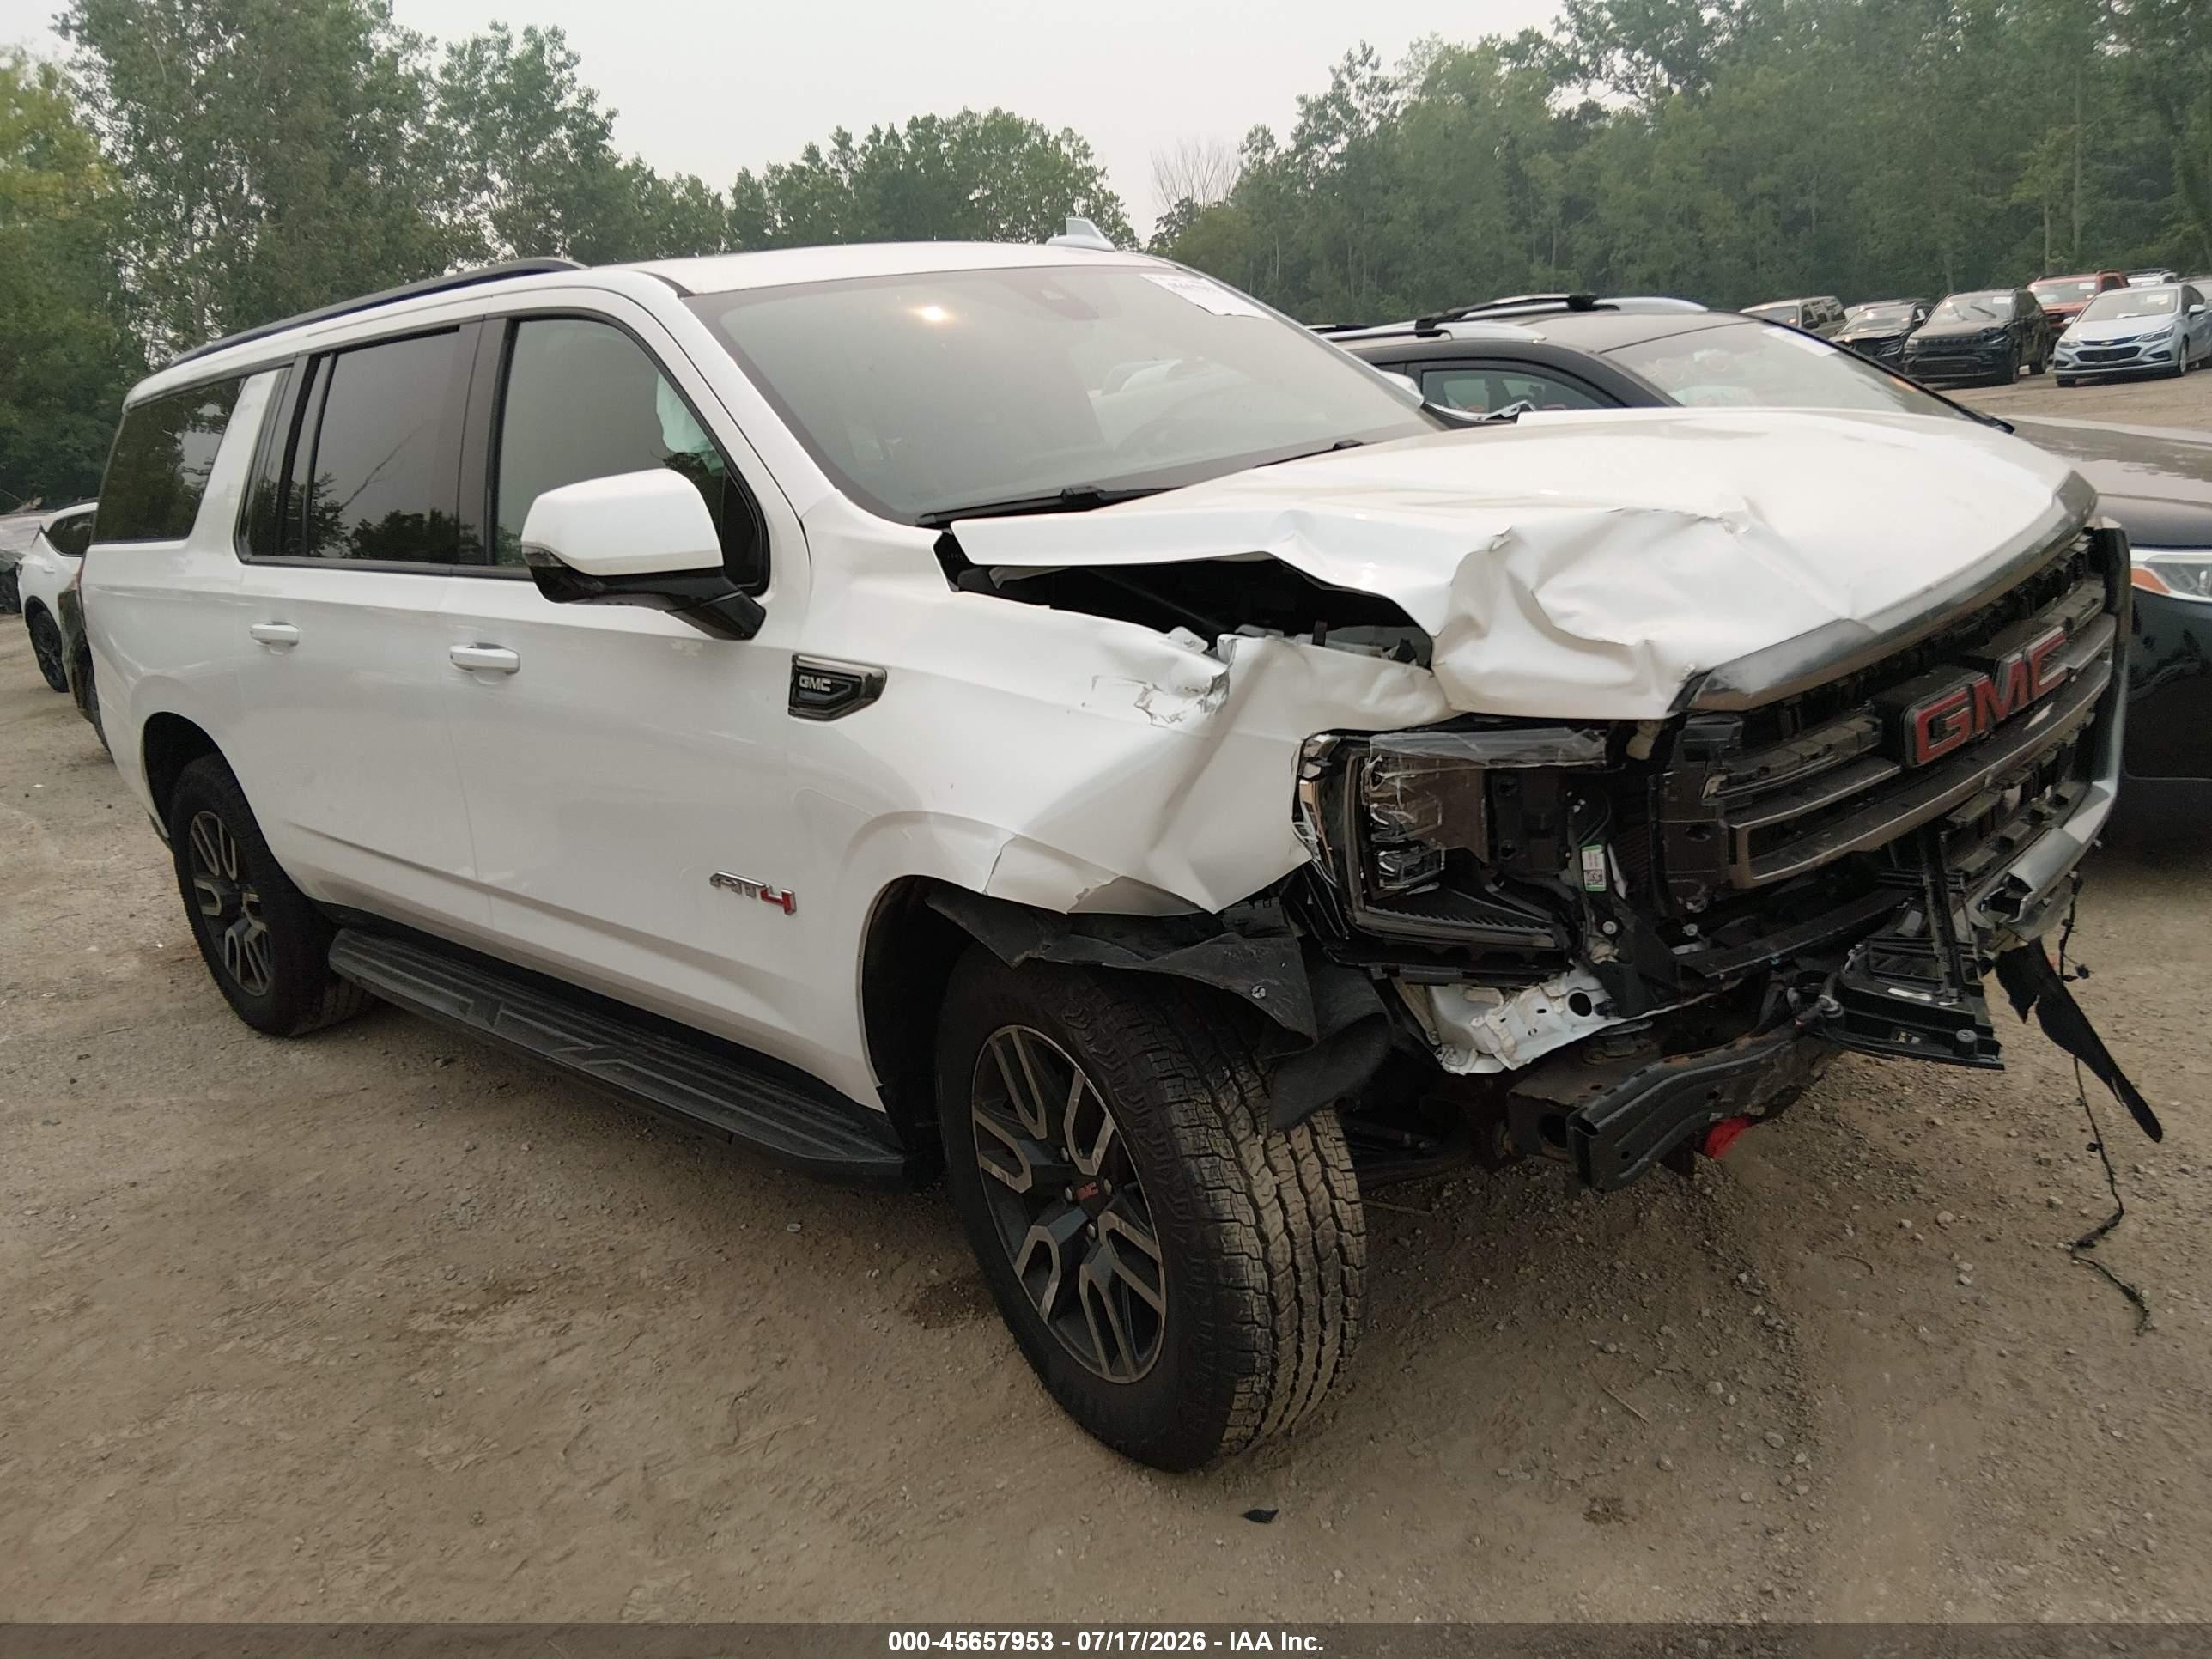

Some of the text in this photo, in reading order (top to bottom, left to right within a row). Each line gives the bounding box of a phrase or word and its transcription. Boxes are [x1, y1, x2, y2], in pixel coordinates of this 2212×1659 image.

[798, 673, 832, 693] GMC
[1906, 625, 2068, 766] GMC
[709, 871, 797, 916] AT4
